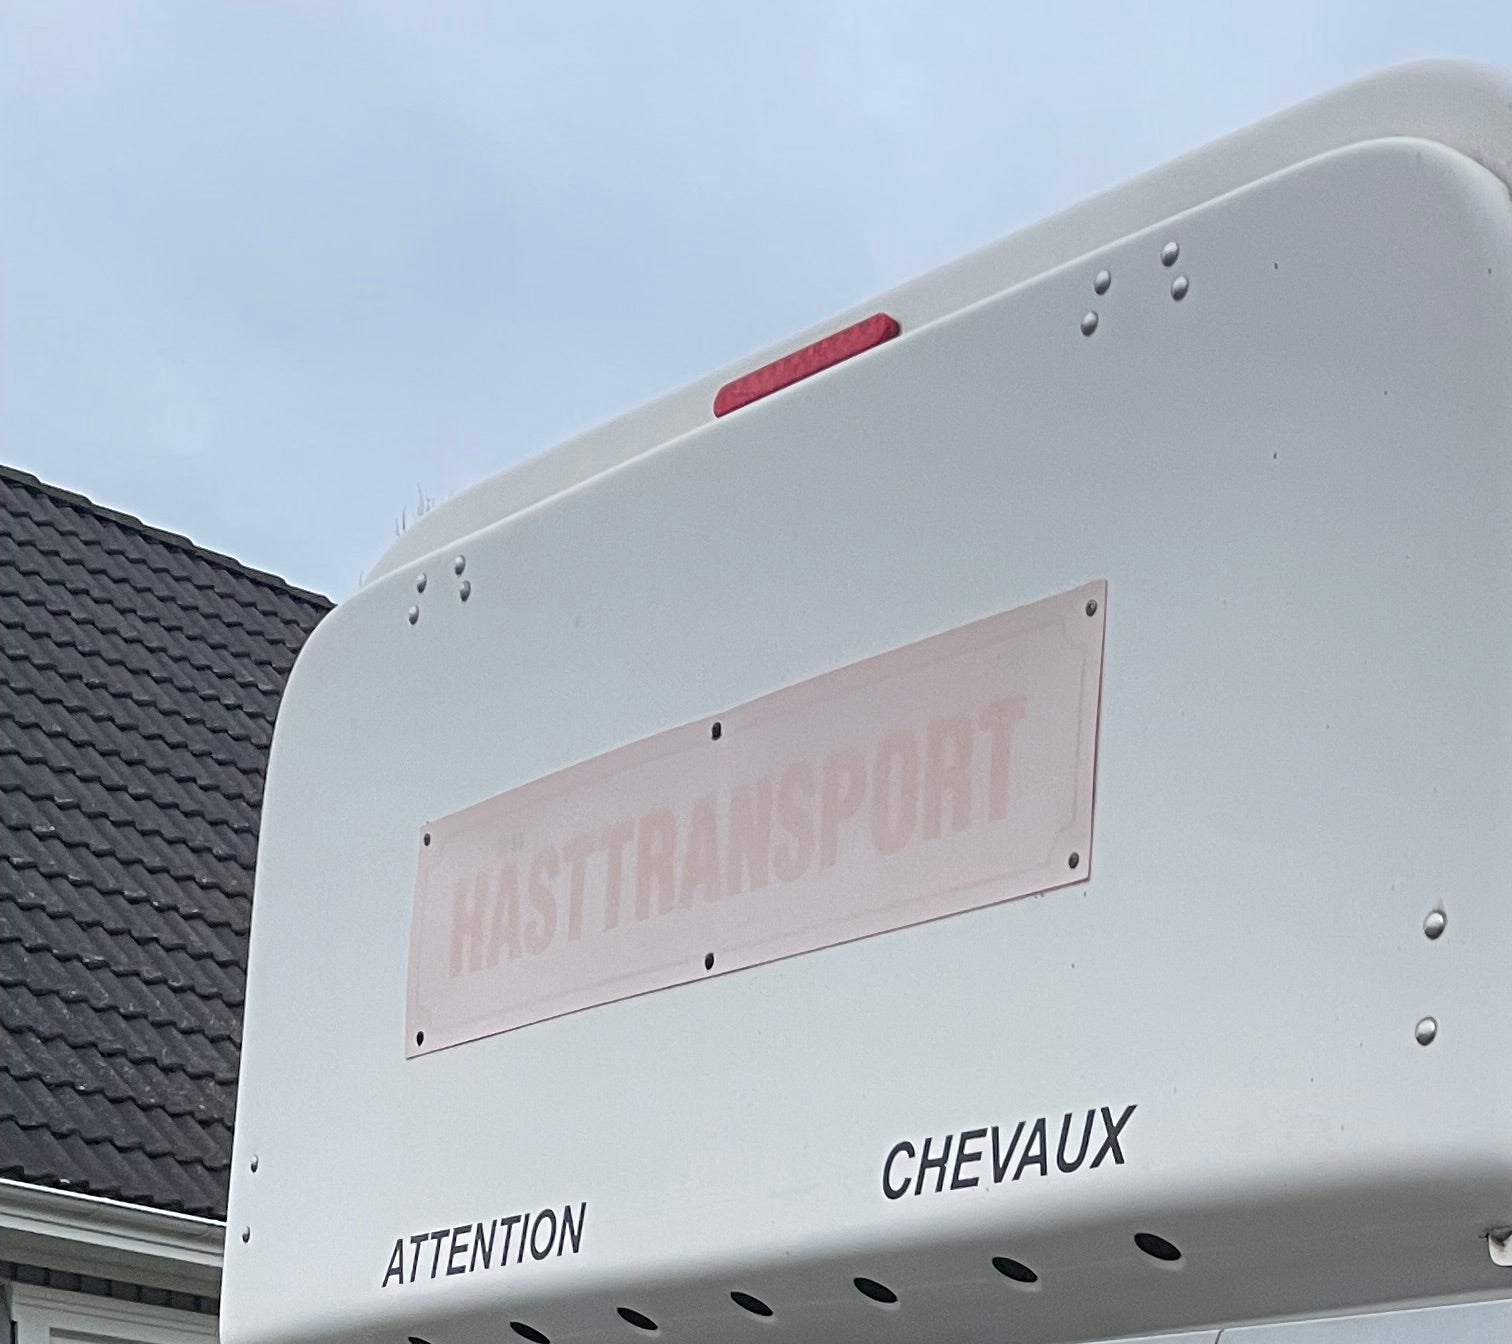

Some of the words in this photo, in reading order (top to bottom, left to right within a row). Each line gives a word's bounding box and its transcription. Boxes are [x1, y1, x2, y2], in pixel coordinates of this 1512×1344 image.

[448, 694, 1027, 979] HÄSTTRANSPORT
[381, 1201, 587, 1287] ATTENTION
[881, 1103, 1137, 1201] CHEVAUX
